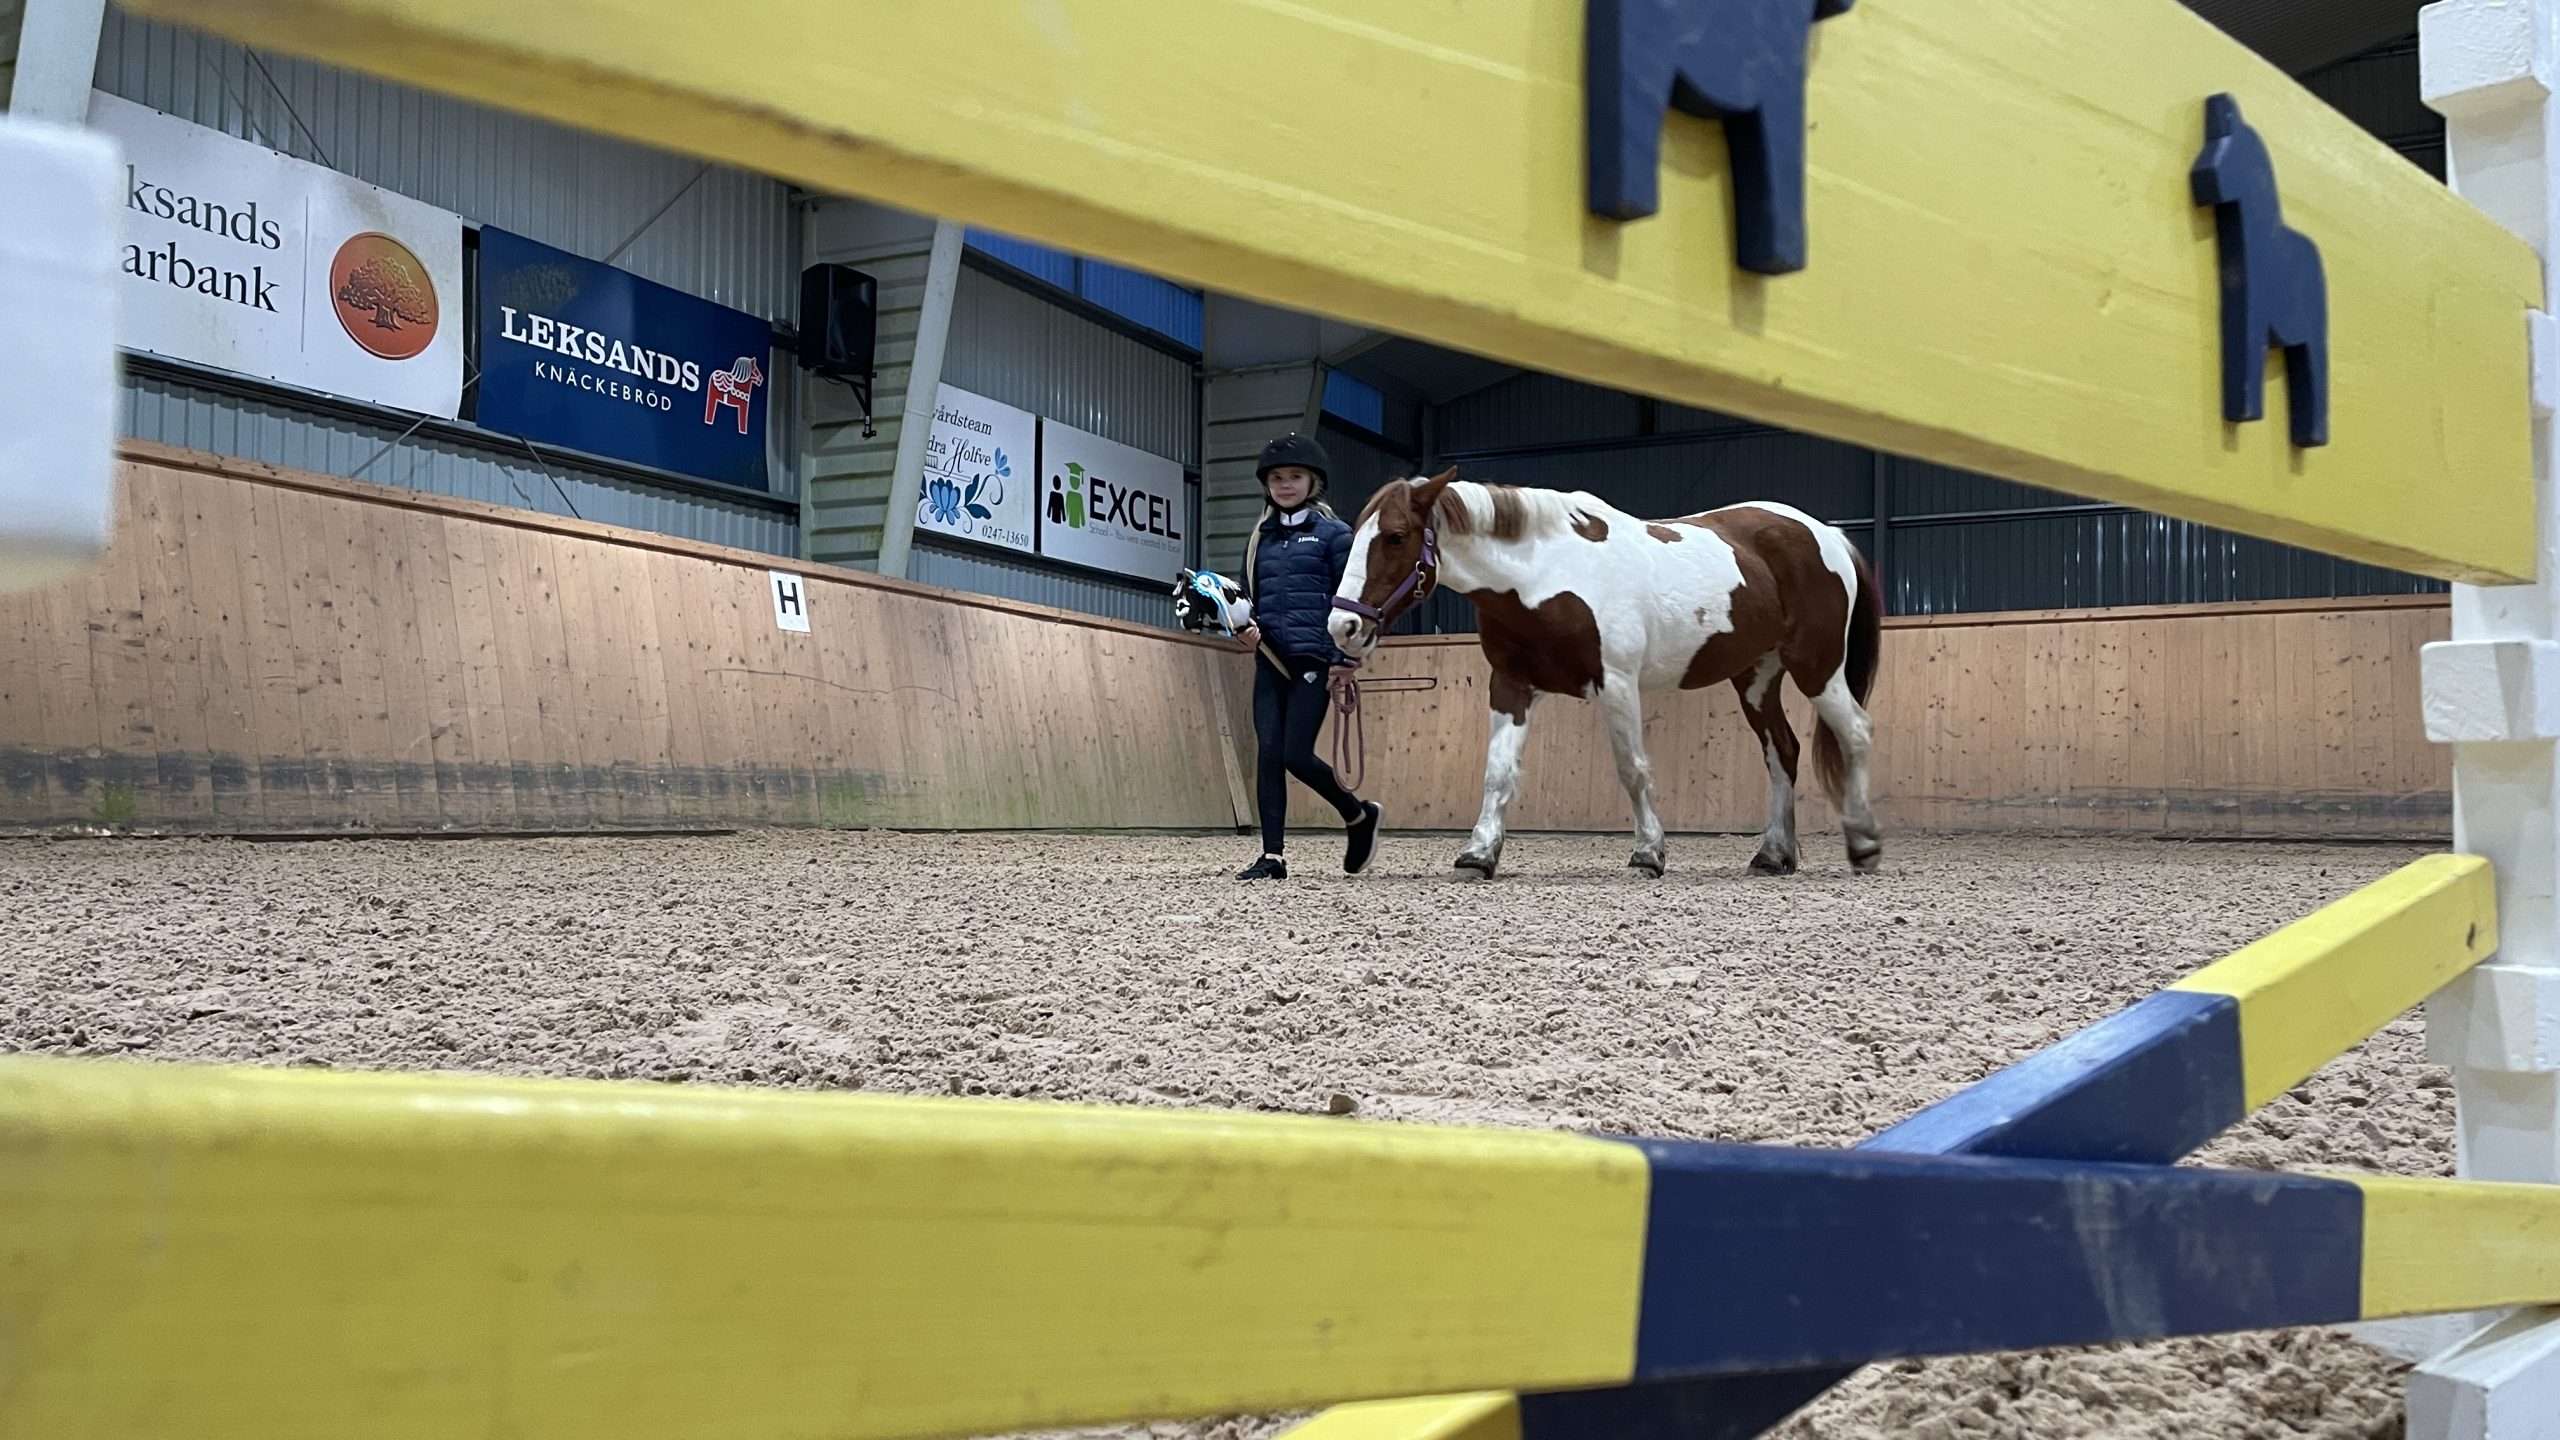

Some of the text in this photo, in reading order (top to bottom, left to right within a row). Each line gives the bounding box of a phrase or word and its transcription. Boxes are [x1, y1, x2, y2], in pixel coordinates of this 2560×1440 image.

[126, 164, 281, 250] ksands
[121, 241, 280, 313] arbank
[501, 306, 700, 392] LEKSANDS
[535, 361, 672, 411] KNÄCKEBRÖD
[932, 405, 992, 435] vårdsteam
[927, 435, 991, 478] dra Holfve
[1090, 477, 1181, 540] EXCEL
[982, 525, 1029, 548] 0247-13650
[777, 580, 800, 615] H
